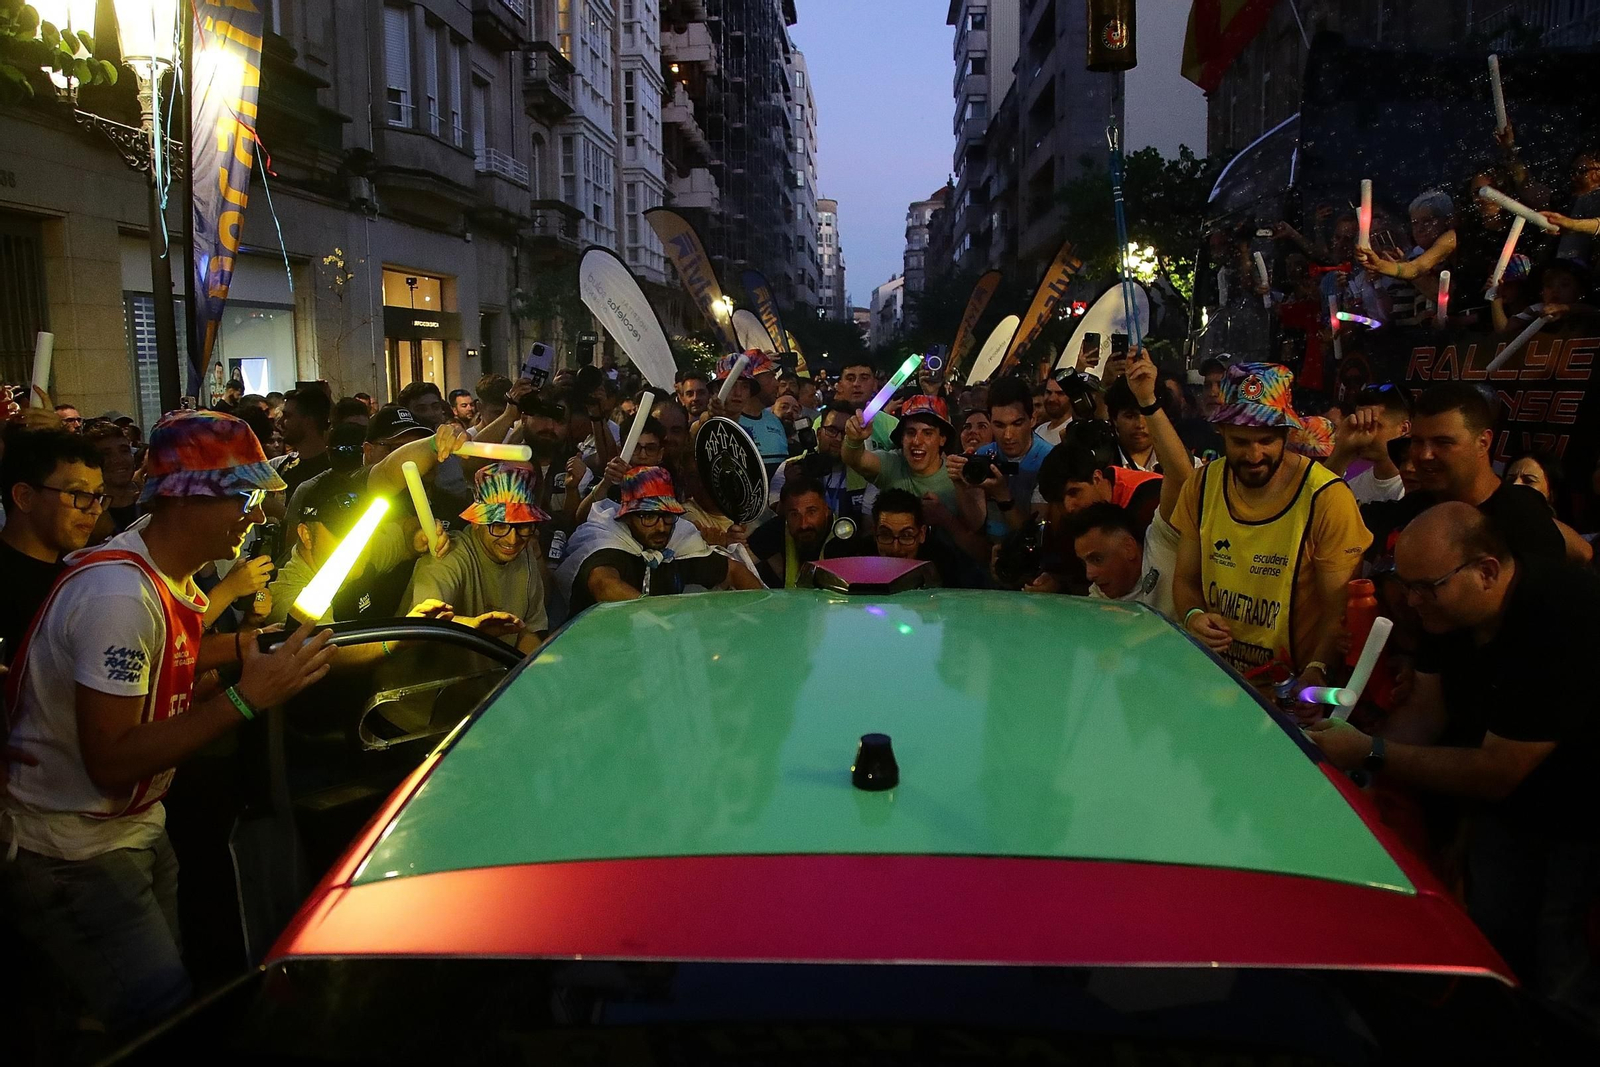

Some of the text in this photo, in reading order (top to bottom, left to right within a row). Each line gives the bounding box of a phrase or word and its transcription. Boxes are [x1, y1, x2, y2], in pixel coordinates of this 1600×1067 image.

[1405, 337, 1600, 381] RALLYE
[1249, 565, 1281, 577] ourense
[104, 657, 145, 672] RALLY
[107, 669, 142, 683] TEAM
